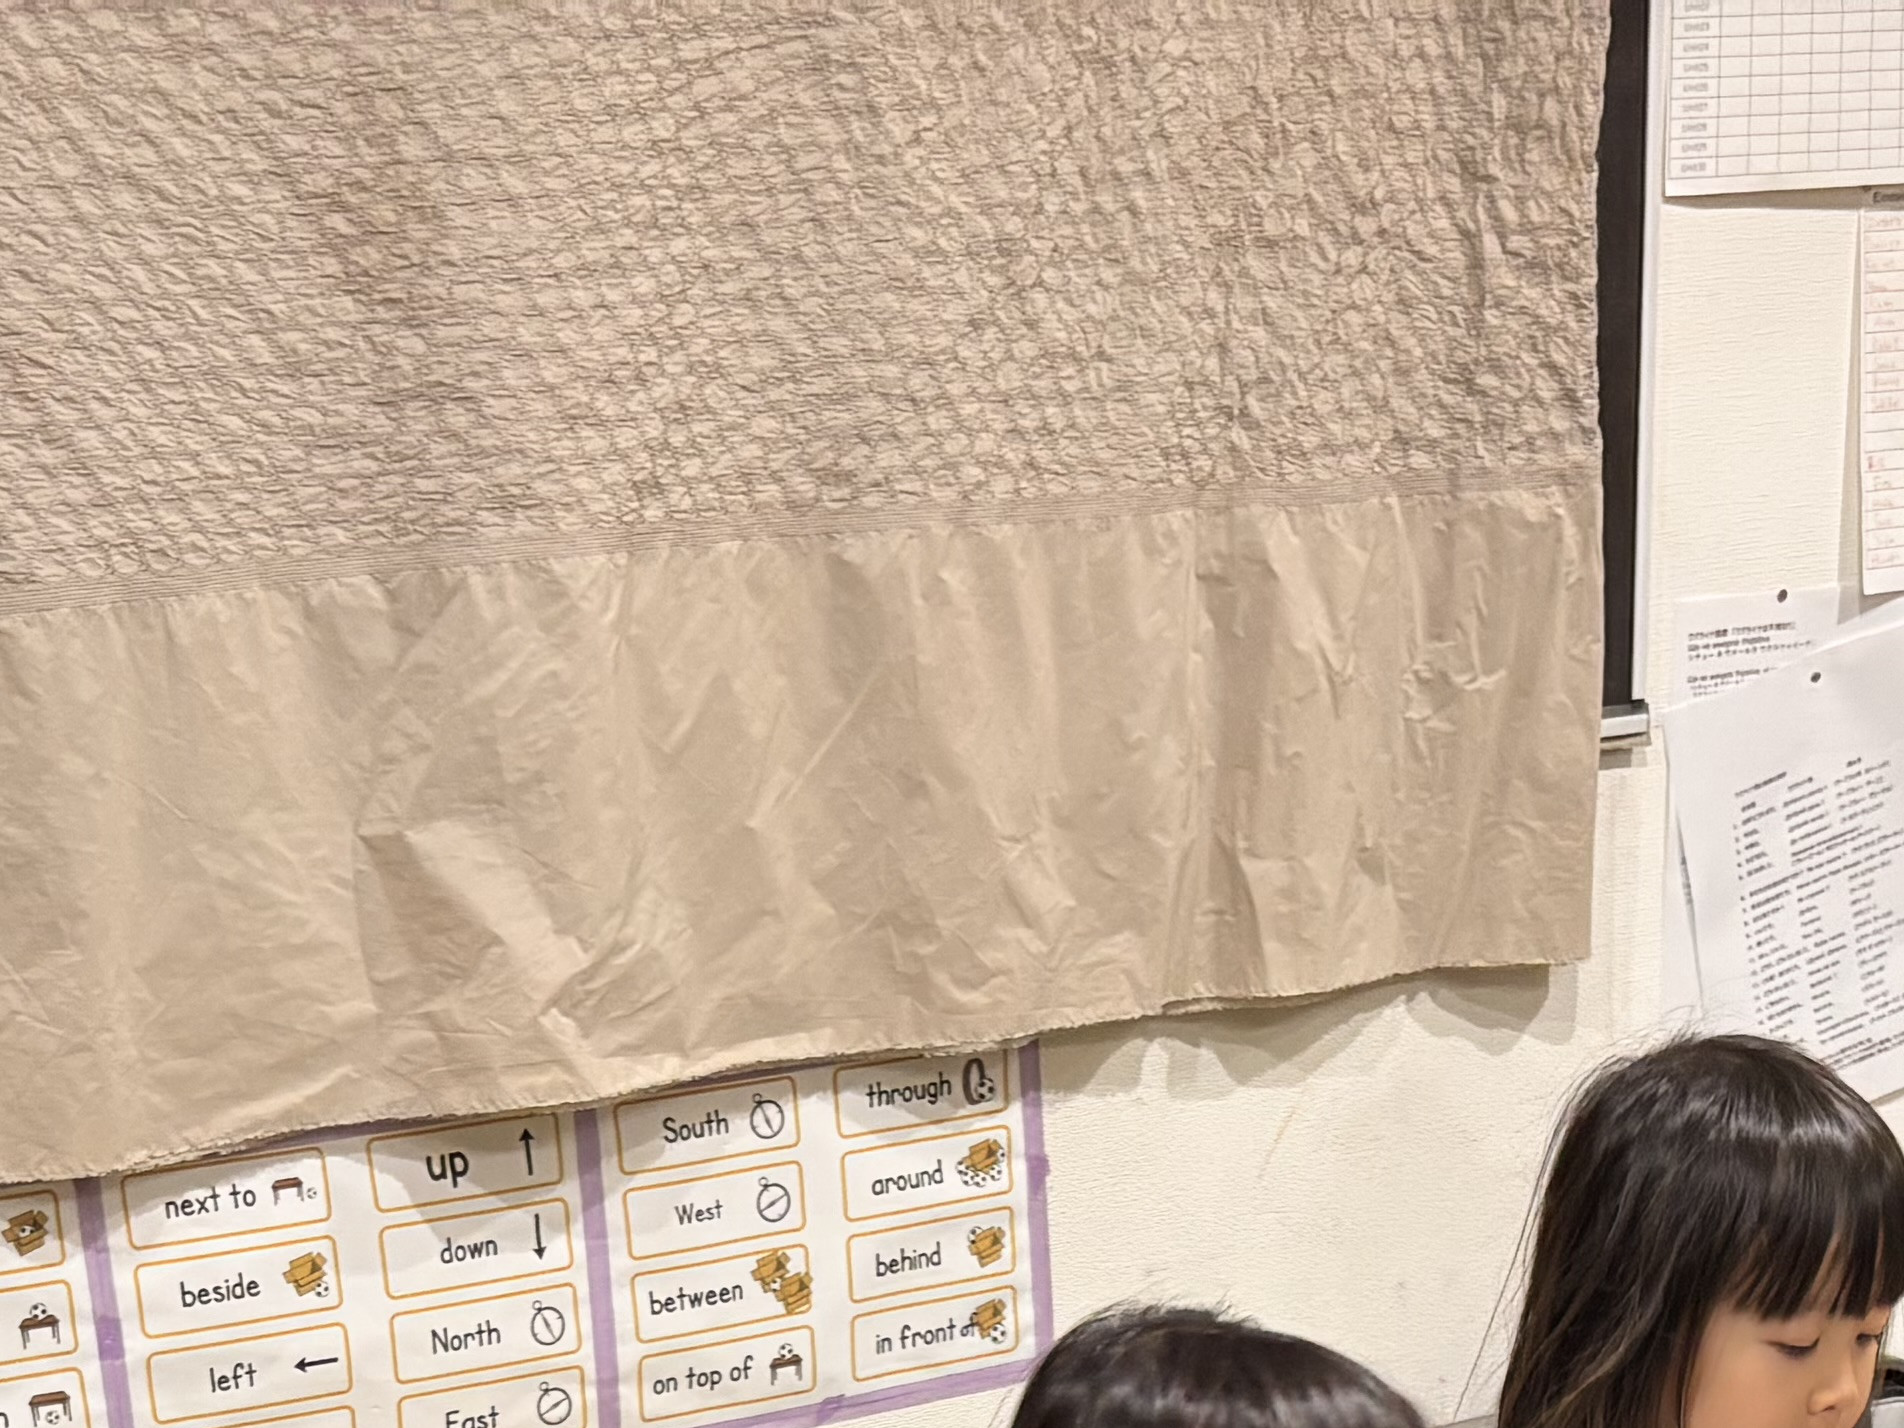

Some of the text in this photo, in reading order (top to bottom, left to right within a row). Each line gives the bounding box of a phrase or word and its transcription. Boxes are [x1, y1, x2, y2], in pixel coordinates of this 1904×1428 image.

[865, 1072, 953, 1108] through
[662, 1111, 730, 1145] South
[426, 1149, 470, 1187] up
[870, 1160, 944, 1197] around
[164, 1177, 257, 1220] next to
[674, 1201, 724, 1226] West
[439, 1237, 500, 1264] down
[874, 1242, 942, 1278] behind
[178, 1273, 262, 1309] beside
[648, 1281, 744, 1316] between
[430, 1319, 502, 1355] North
[875, 1334, 892, 1355] in
[899, 1317, 957, 1349] front
[209, 1364, 258, 1394] left
[651, 1355, 754, 1396] on top of
